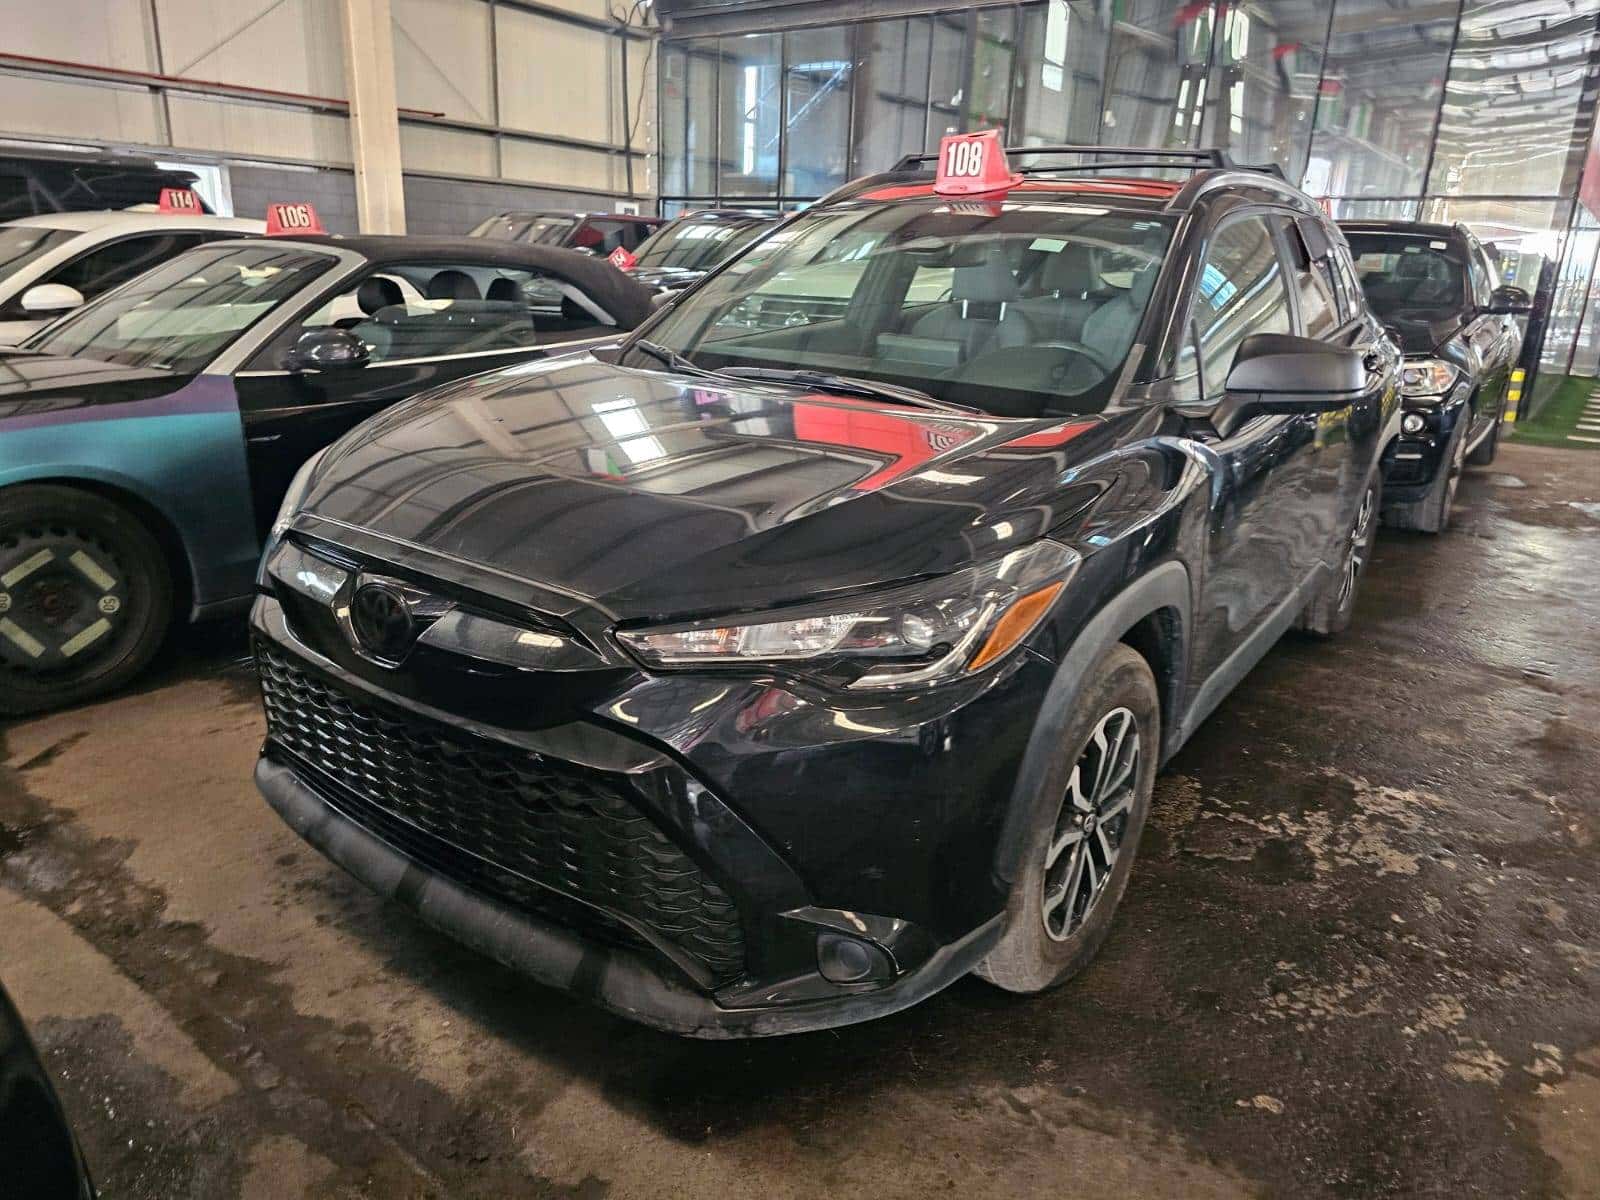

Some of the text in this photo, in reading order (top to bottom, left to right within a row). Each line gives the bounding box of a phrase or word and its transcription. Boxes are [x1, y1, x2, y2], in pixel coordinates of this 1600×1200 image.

[947, 141, 982, 177] 108
[171, 191, 194, 208] 114
[277, 205, 311, 228] 106
